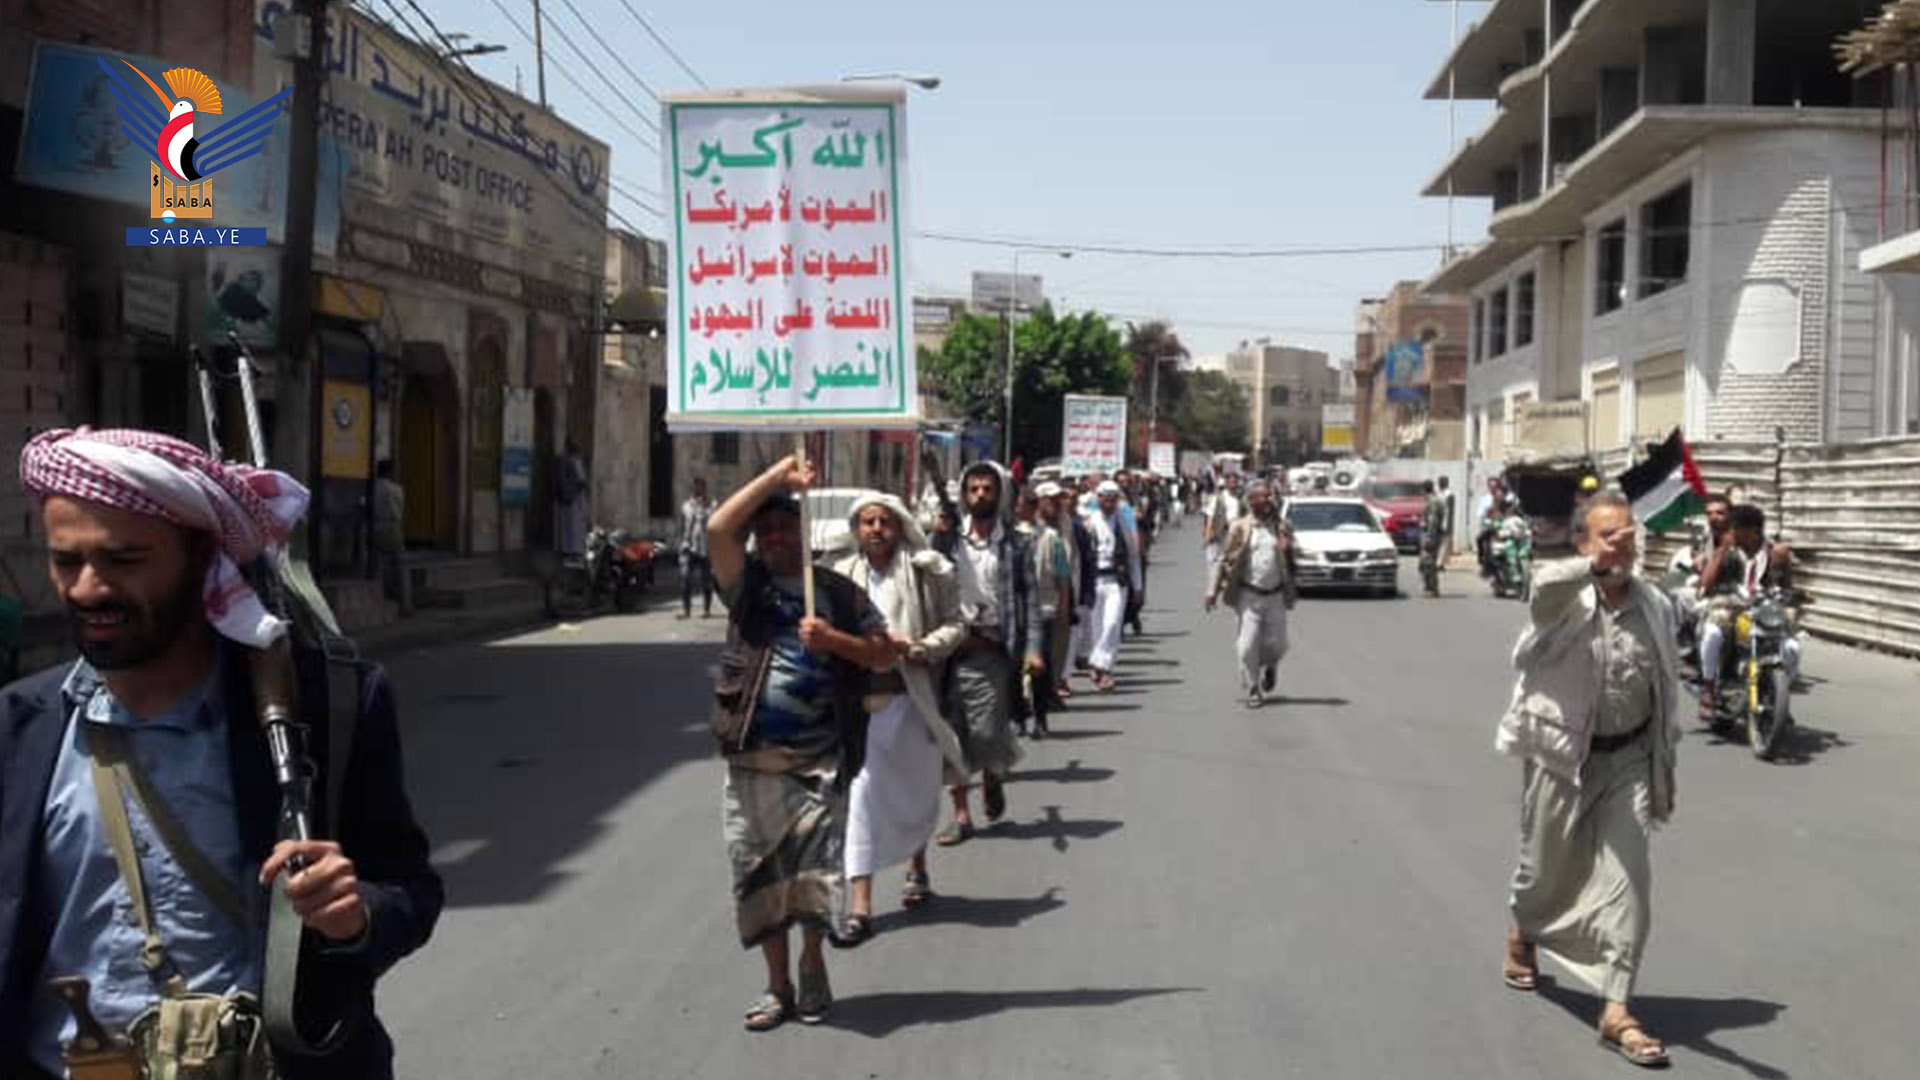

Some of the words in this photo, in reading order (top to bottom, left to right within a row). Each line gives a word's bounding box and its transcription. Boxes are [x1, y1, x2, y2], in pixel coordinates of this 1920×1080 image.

[371, 52, 450, 136] بريد
[683, 111, 804, 185] أكبر
[812, 118, 885, 168] الله
[421, 143, 472, 190] POST
[475, 166, 533, 212] OFFICE
[686, 182, 791, 231] لأمريكا
[801, 189, 886, 231] الموت
[803, 243, 888, 284] الموت
[690, 298, 764, 338] اليهود
[774, 298, 813, 336] على
[825, 296, 890, 330] اللعنة
[692, 347, 792, 405] للإسلام
[804, 341, 893, 400] النصر
